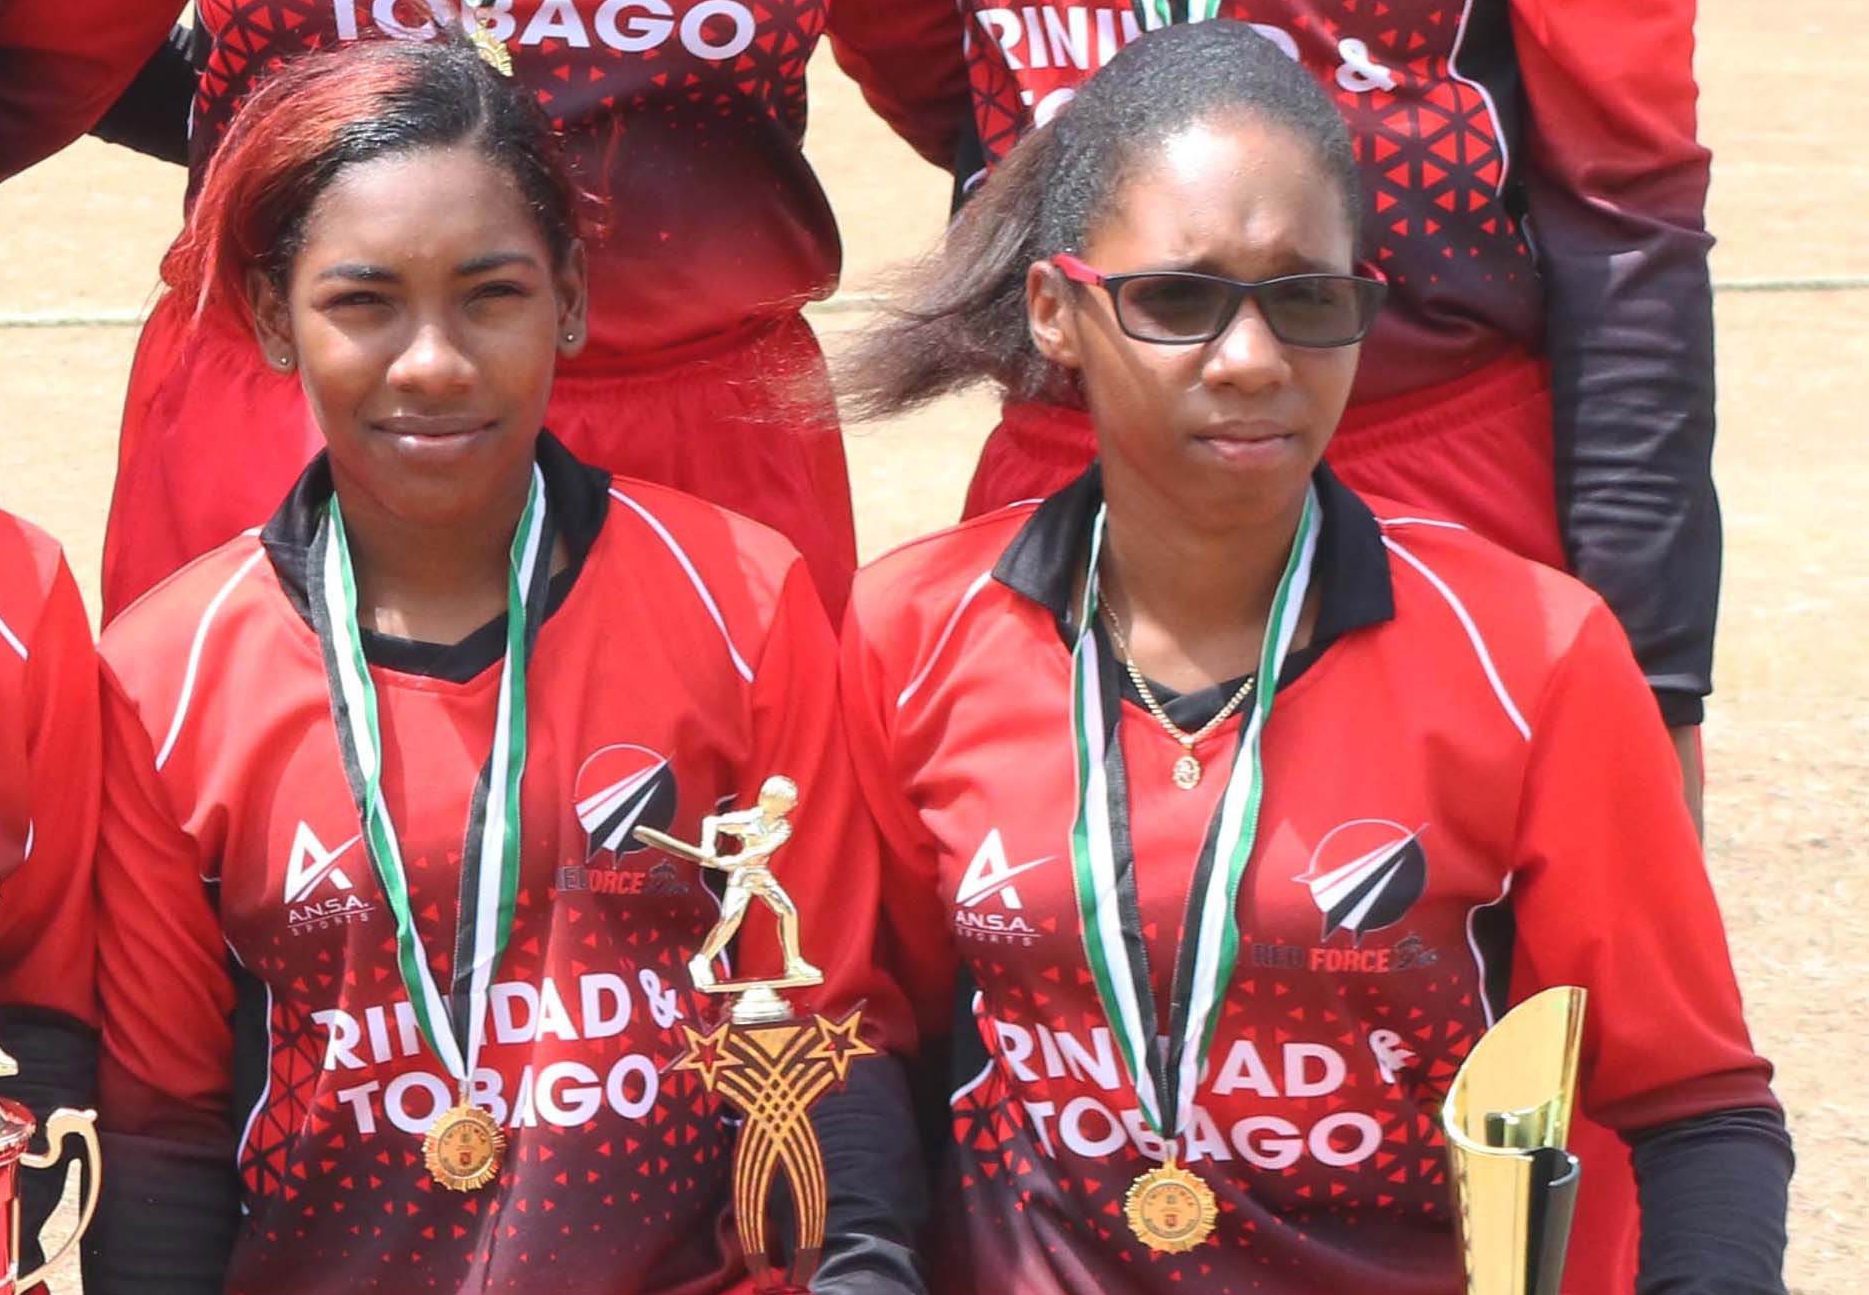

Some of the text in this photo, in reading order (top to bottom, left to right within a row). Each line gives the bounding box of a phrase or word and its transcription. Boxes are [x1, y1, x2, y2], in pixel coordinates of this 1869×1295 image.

[1336, 38, 1398, 93] &
[1309, 948, 1391, 974] FORCE
[638, 968, 683, 1028] &
